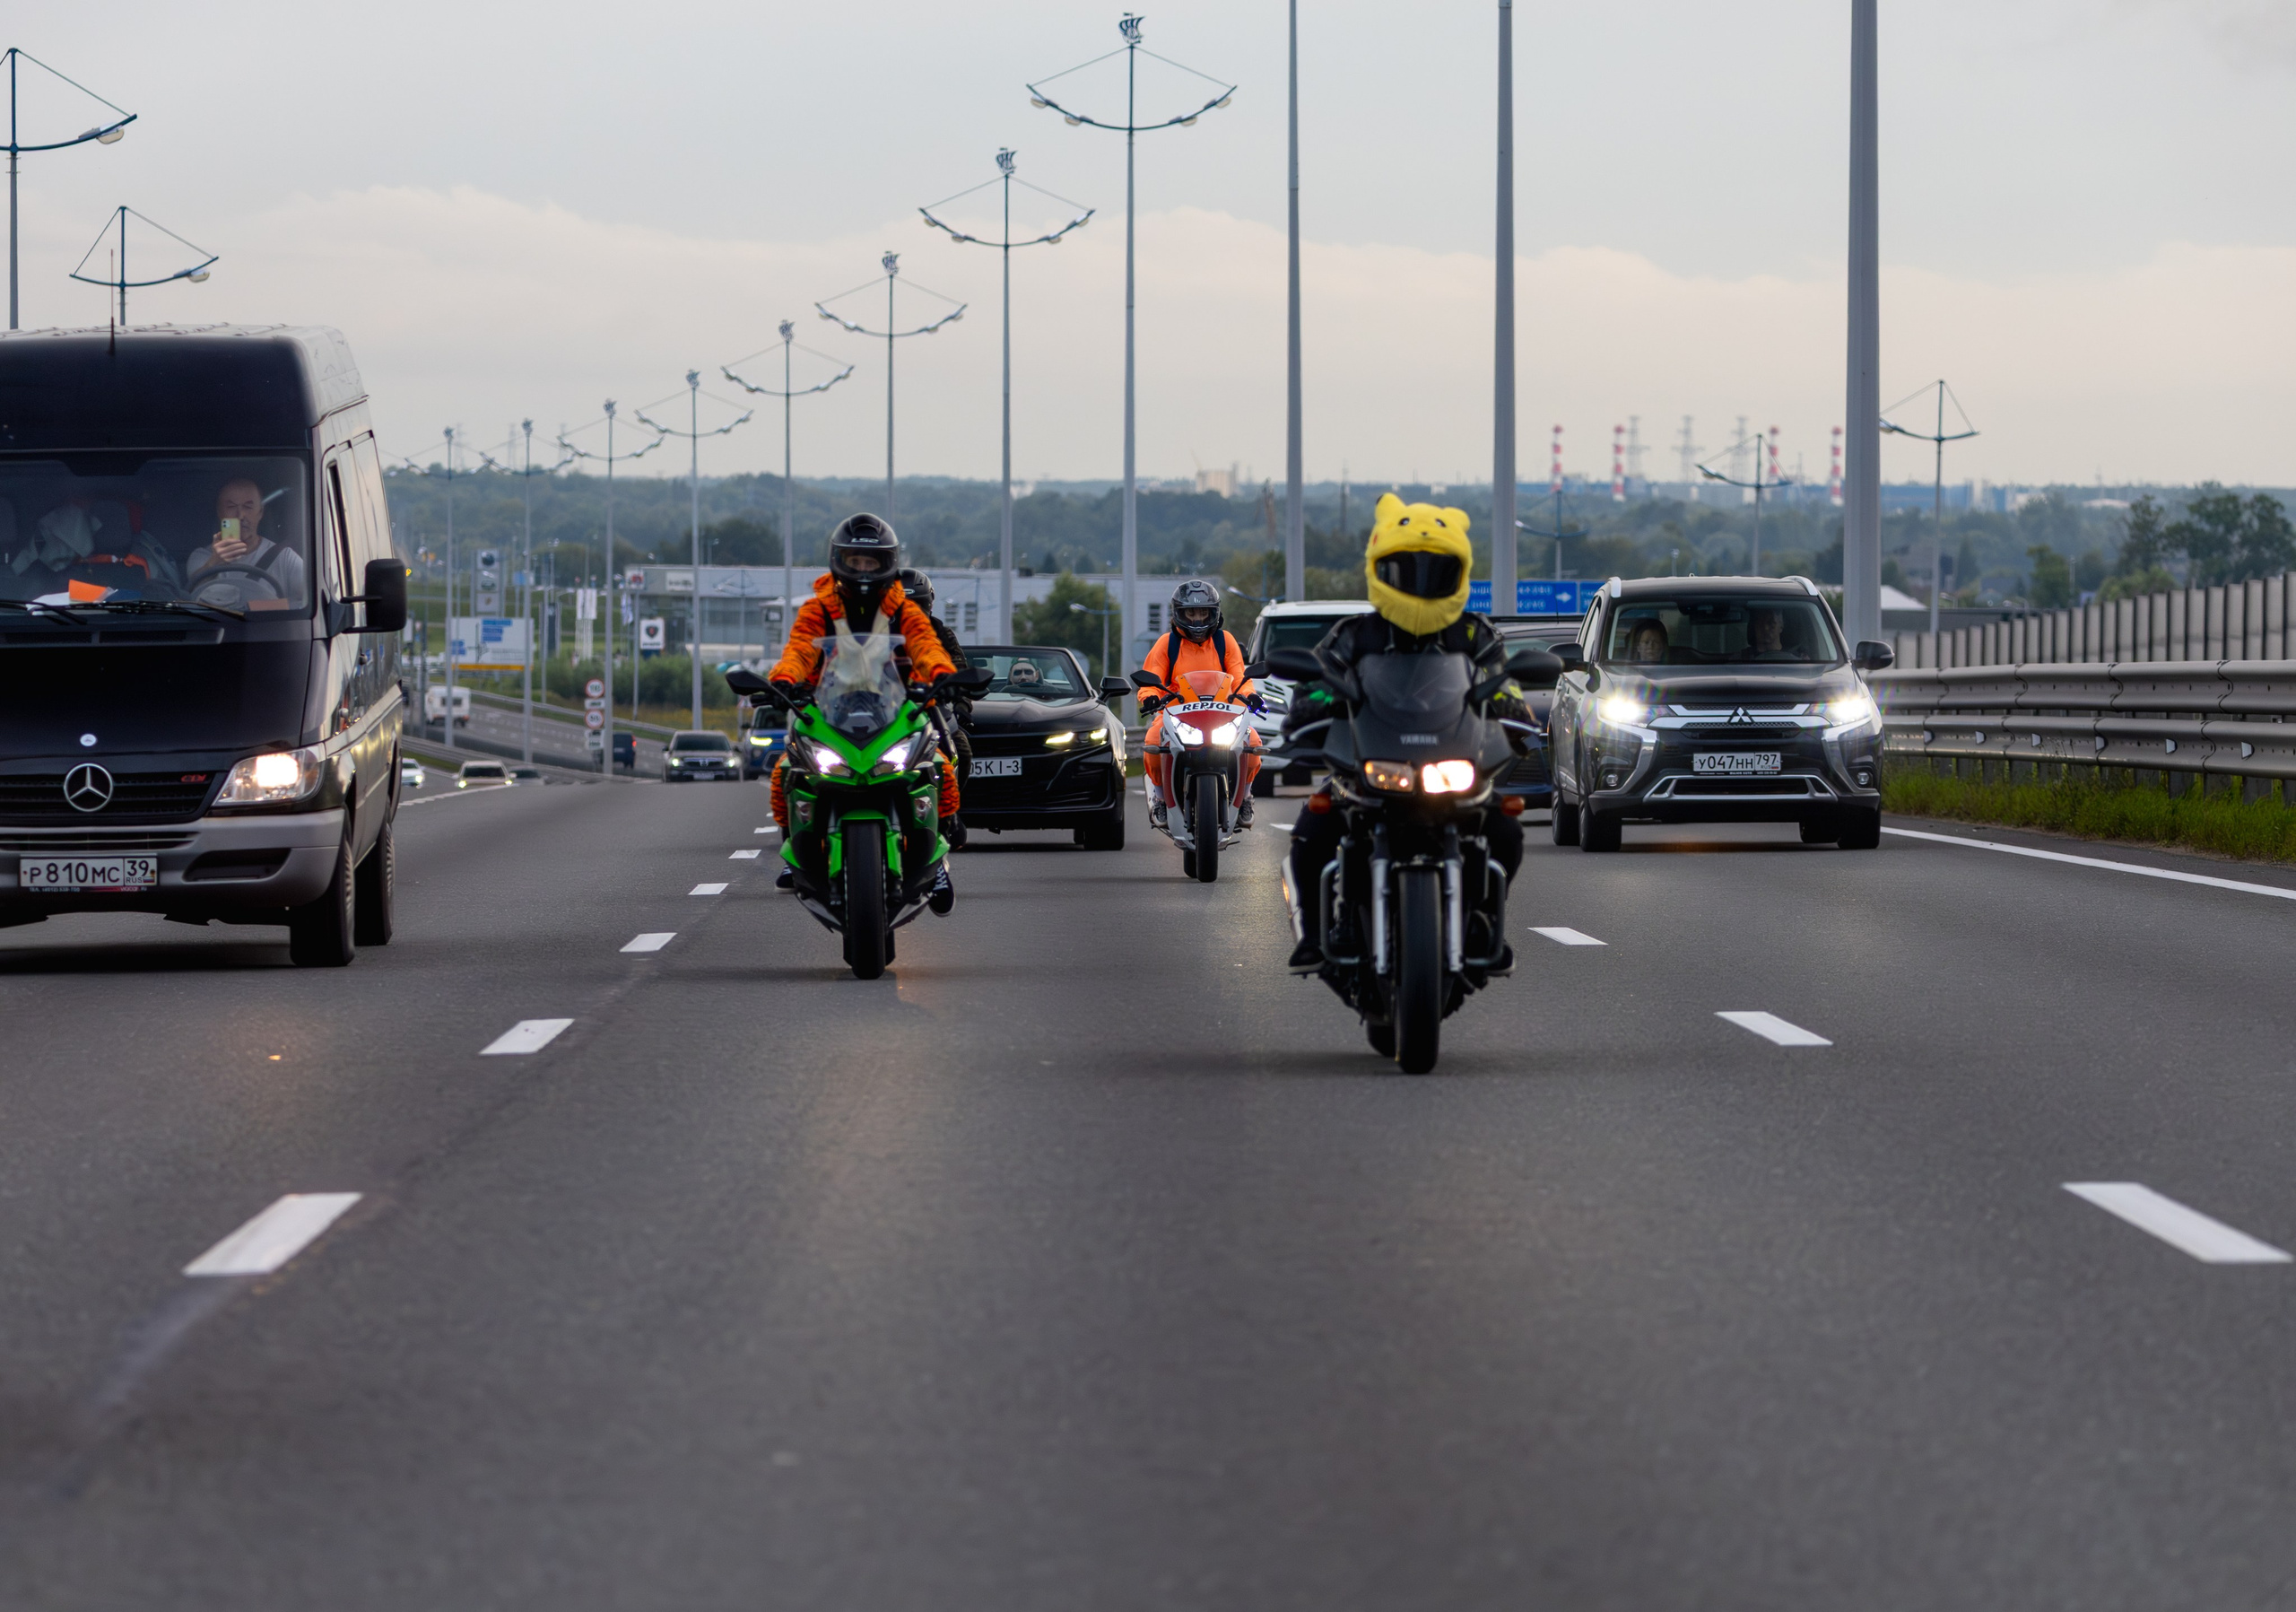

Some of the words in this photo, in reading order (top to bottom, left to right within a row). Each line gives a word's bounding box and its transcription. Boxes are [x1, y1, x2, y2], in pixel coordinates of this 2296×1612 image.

[1182, 702, 1231, 711] REPSOL
[1400, 735, 1438, 745] YAMAHA
[1755, 754, 1777, 765] 797
[126, 860, 149, 876] 39
